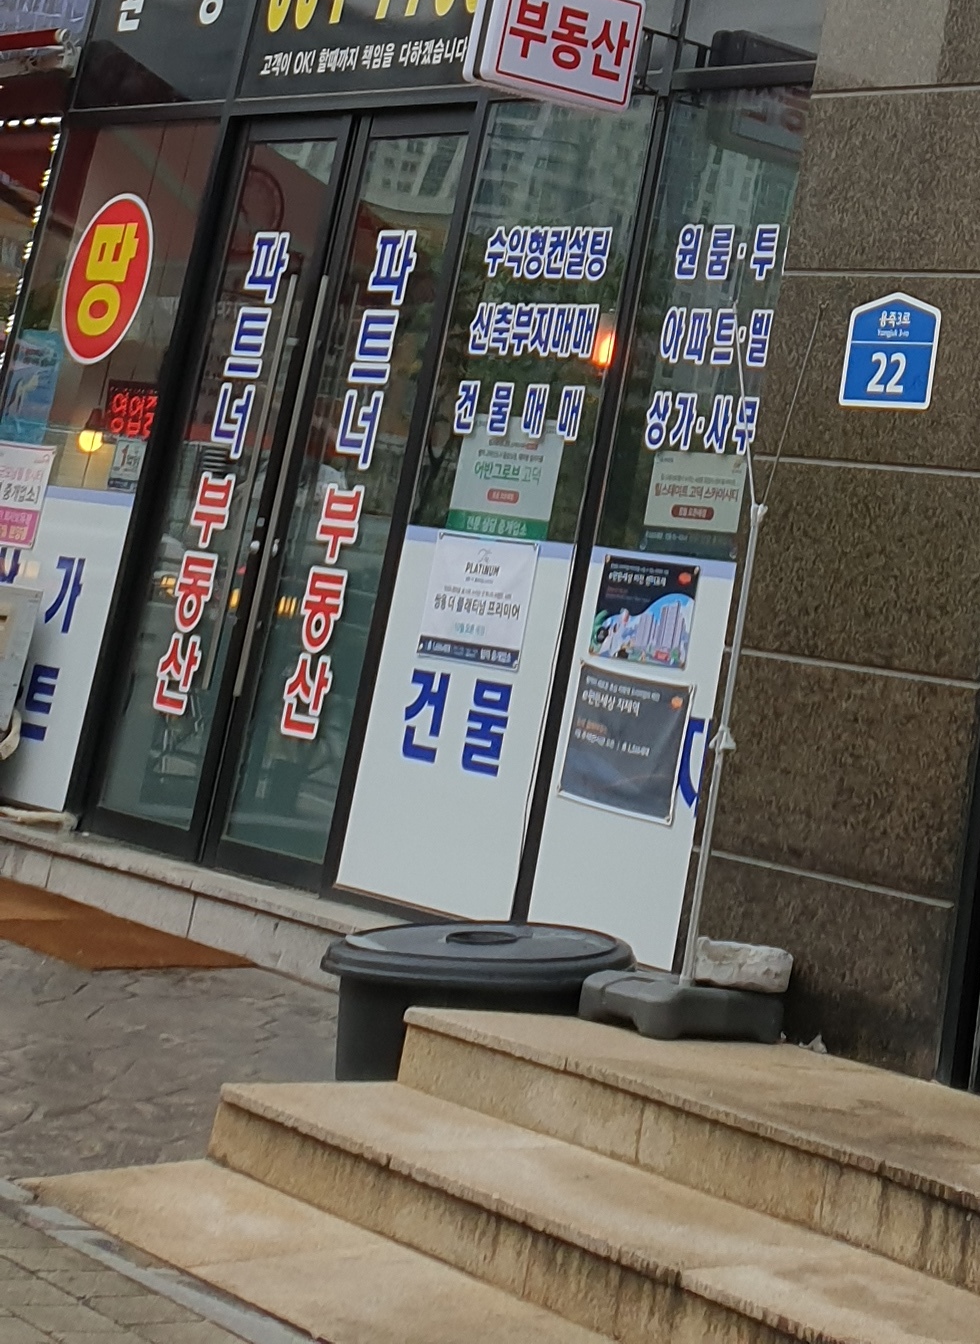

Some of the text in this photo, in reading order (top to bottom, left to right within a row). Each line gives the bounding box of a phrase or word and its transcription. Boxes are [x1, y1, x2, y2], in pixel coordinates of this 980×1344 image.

[260, 35, 468, 78] 고객이 OK! 할때까지 책임을 다하겠습니다
[75, 220, 139, 338] 땅
[484, 224, 613, 282] 수익형컨설팅
[468, 300, 601, 361] 신축부지매매
[866, 351, 907, 394] 22
[153, 230, 290, 717] 파트너 부동산
[280, 227, 418, 741] 파트너 부동산
[402, 669, 513, 777] 건물
